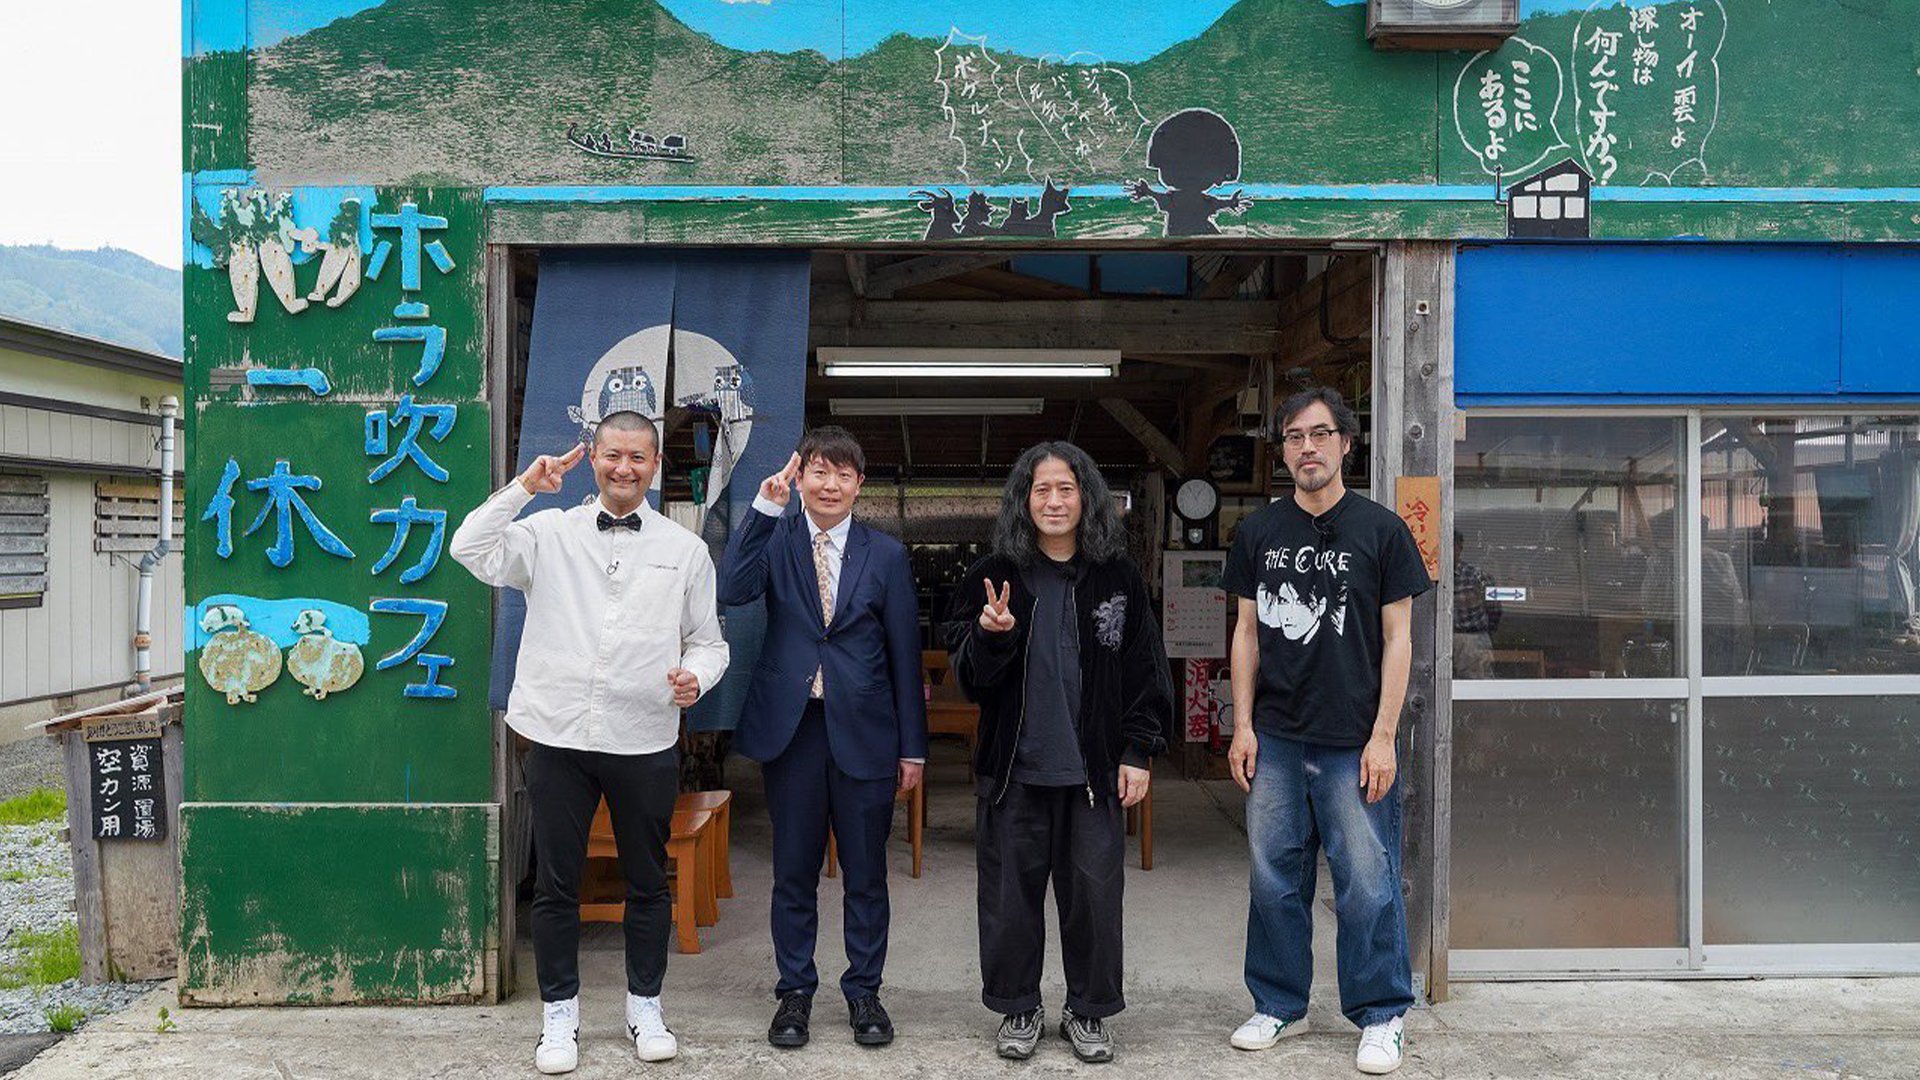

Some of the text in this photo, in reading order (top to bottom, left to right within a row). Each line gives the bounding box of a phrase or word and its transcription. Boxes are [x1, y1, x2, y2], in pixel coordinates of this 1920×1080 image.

[1479, 69, 1507, 160] あるよ
[1511, 60, 1538, 133] ここに
[201, 366, 356, 568] 一休
[365, 201, 458, 699] ホラ吹カフェ
[1264, 544, 1352, 579] THE CURE
[1185, 657, 1209, 738] 消火器
[95, 746, 123, 838] 空カン用
